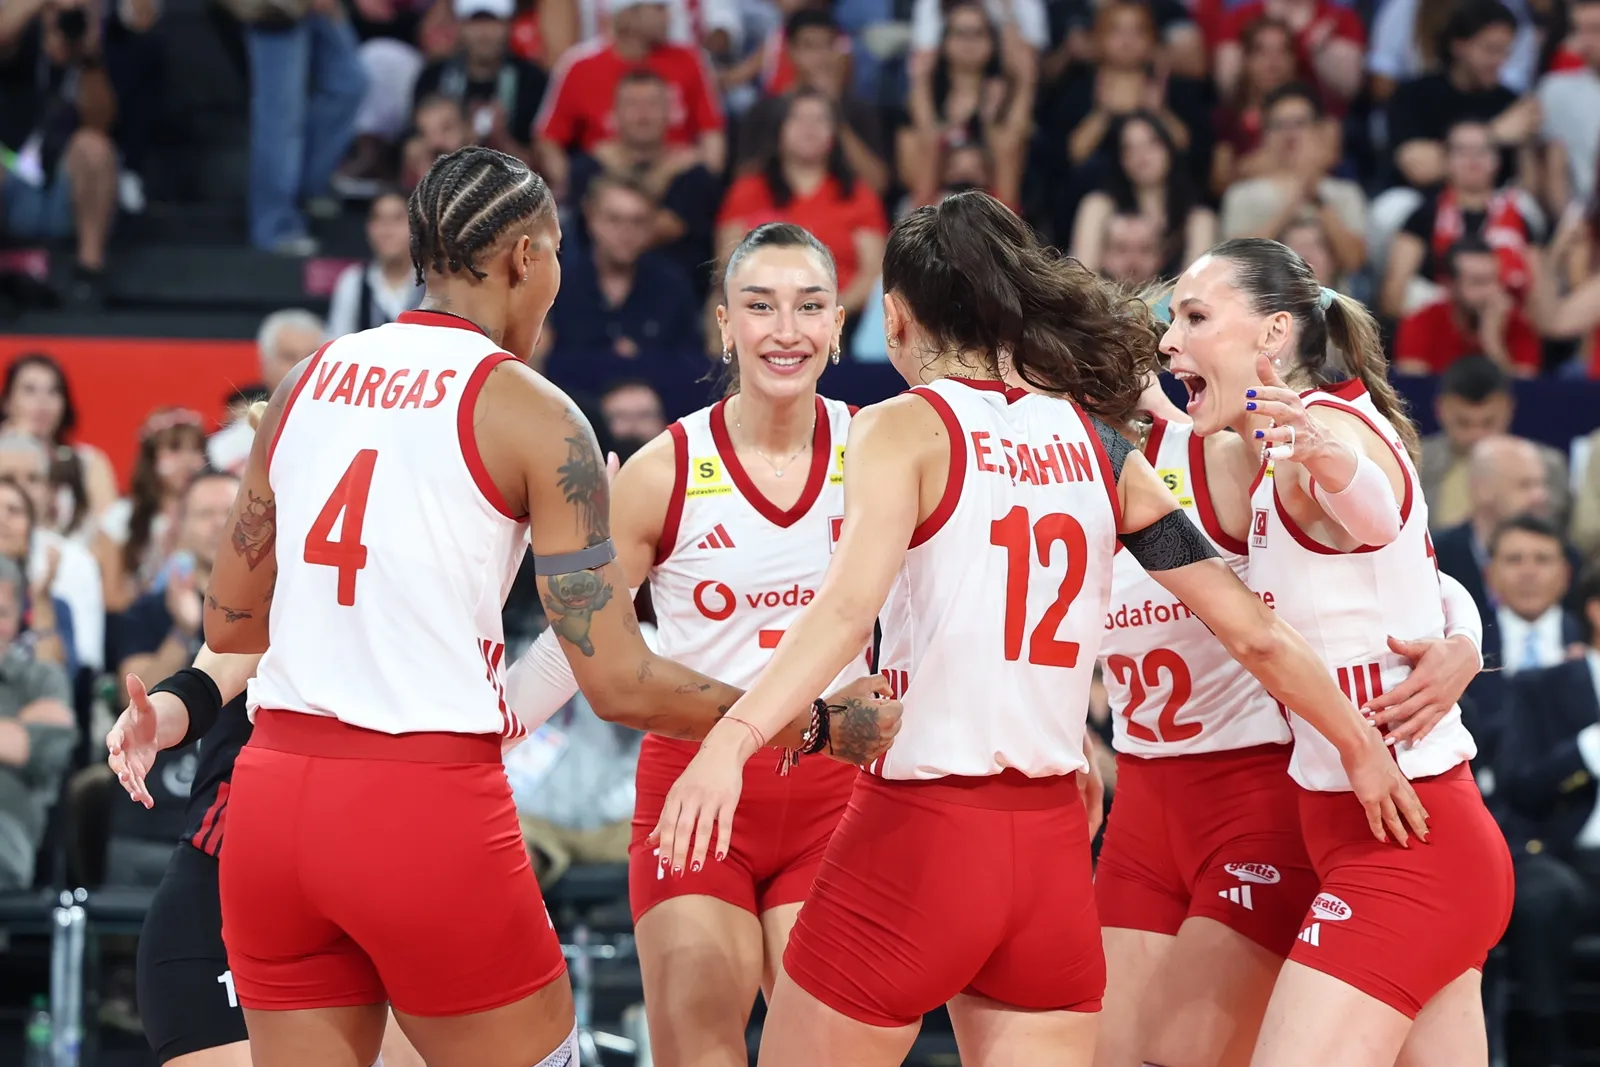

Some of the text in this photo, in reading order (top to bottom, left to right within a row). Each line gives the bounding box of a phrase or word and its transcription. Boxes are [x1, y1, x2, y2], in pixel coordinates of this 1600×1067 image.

[312, 361, 457, 409] VARGAS
[699, 461, 715, 479] S
[1163, 473, 1178, 491] S
[304, 448, 379, 606] 4
[745, 583, 815, 609] voda
[990, 505, 1088, 668] 12
[1104, 600, 1191, 630] odafon
[1107, 648, 1203, 743] 22
[1229, 861, 1277, 879] gratis
[1312, 896, 1348, 917] gratis
[217, 970, 238, 1008] 1
